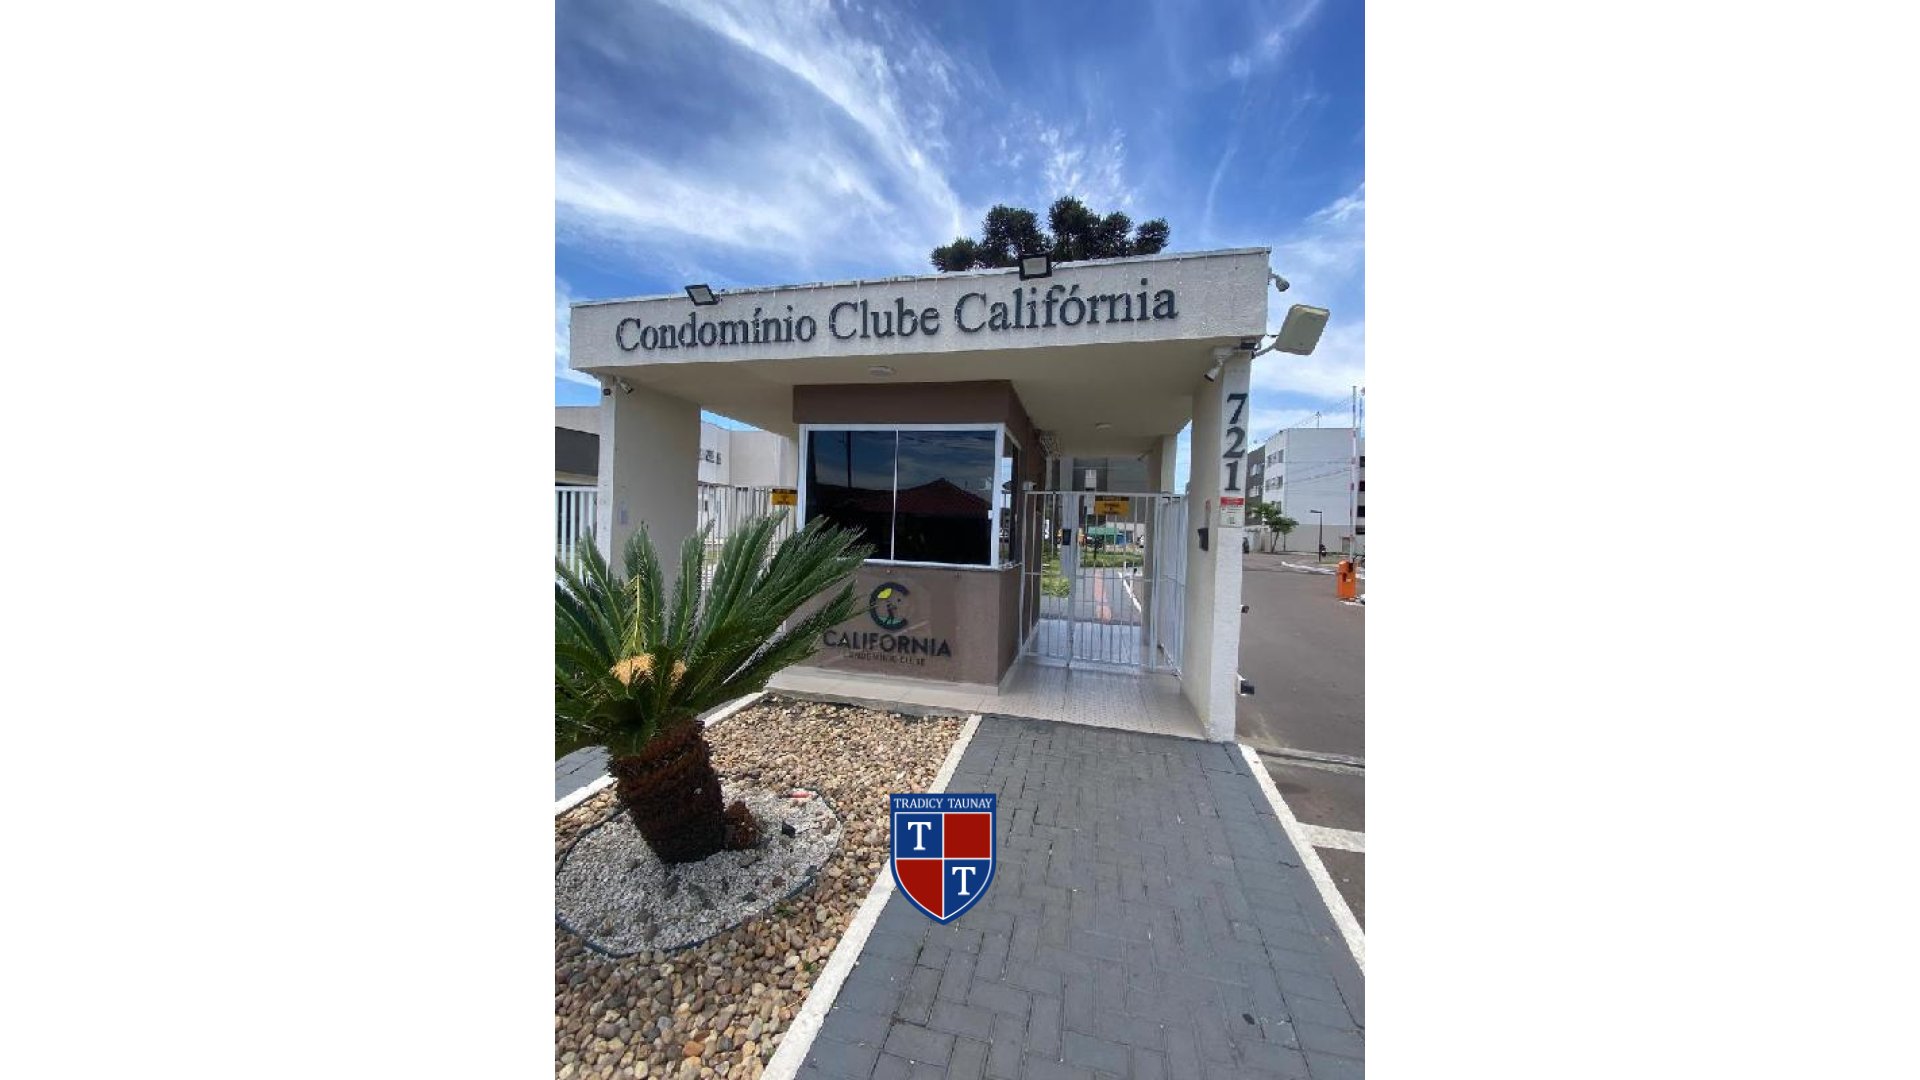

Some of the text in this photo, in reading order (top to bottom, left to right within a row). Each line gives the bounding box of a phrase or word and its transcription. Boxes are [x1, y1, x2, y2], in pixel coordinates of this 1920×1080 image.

[616, 277, 1180, 351] Condomínio Clube Califórnia
[1222, 393, 1249, 492] 721
[822, 629, 952, 657] CALIFORNIA
